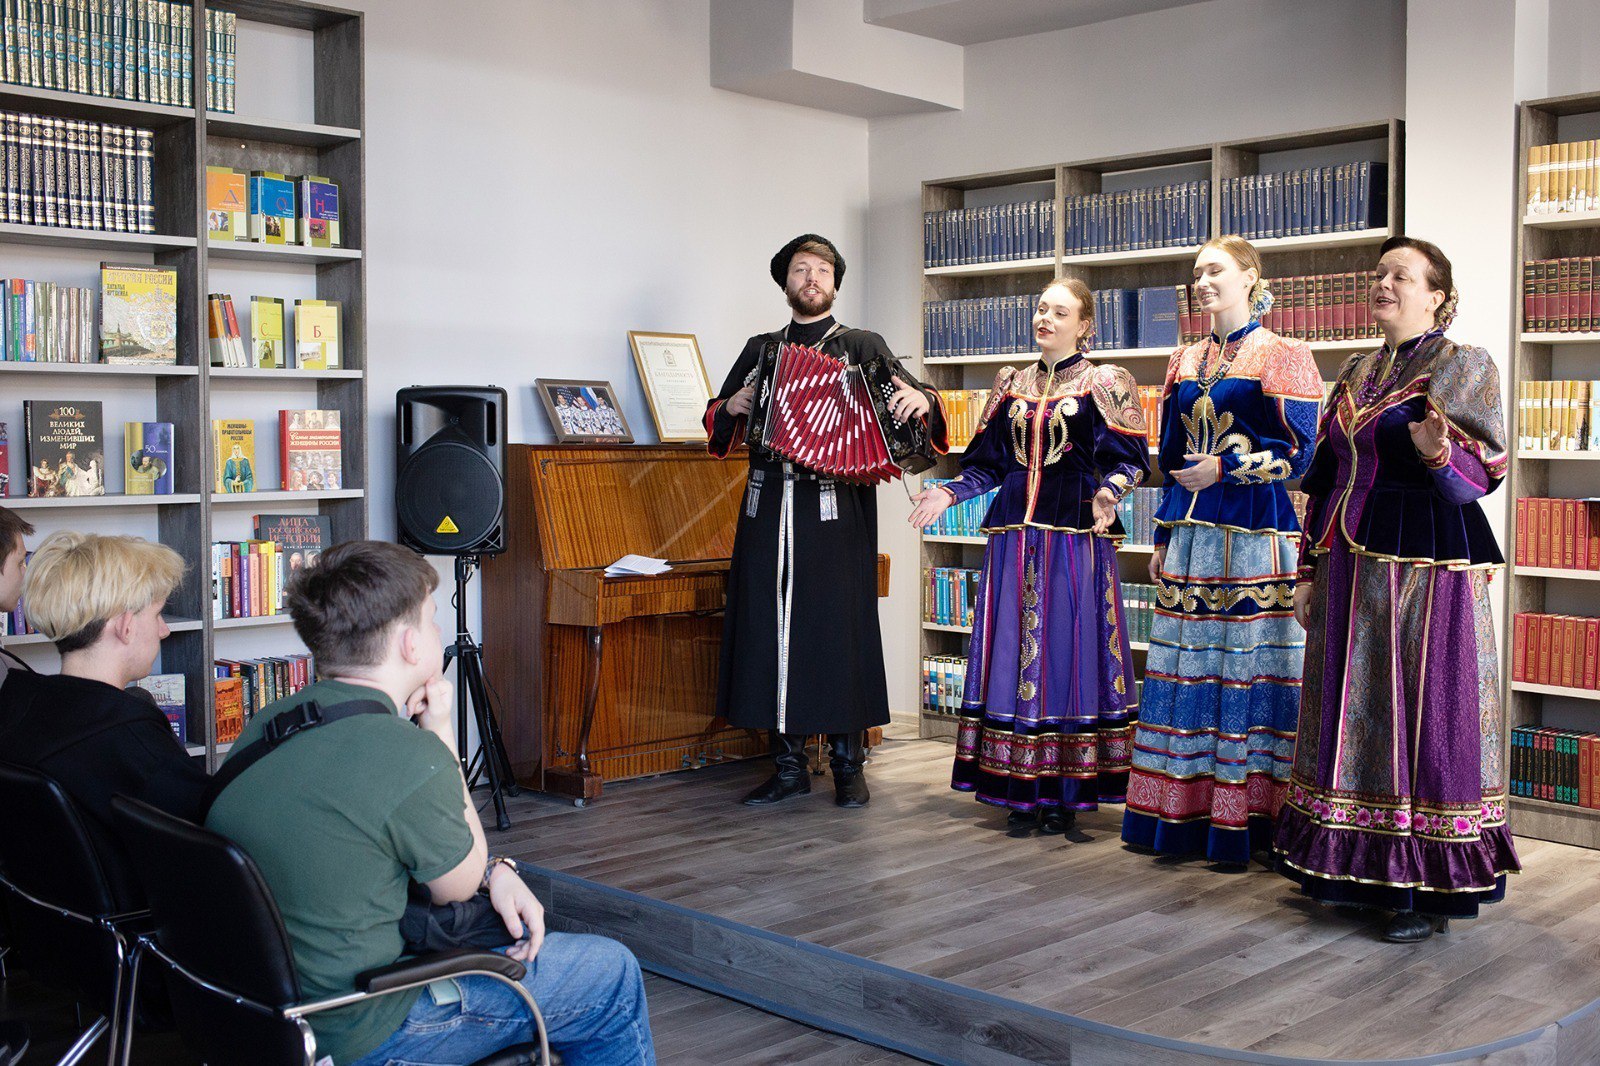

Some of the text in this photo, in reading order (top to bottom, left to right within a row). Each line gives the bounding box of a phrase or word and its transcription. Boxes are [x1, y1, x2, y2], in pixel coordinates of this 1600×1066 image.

[144, 273, 173, 286] РОССИИ
[313, 325, 322, 338] Б
[59, 406, 75, 416] 100
[52, 427, 84, 436] ЛЮДЕЙ,
[40, 435, 95, 443] ИЗМЕНИВШИХ
[59, 442, 77, 450] МИР
[278, 515, 309, 527] ЛИЦА
